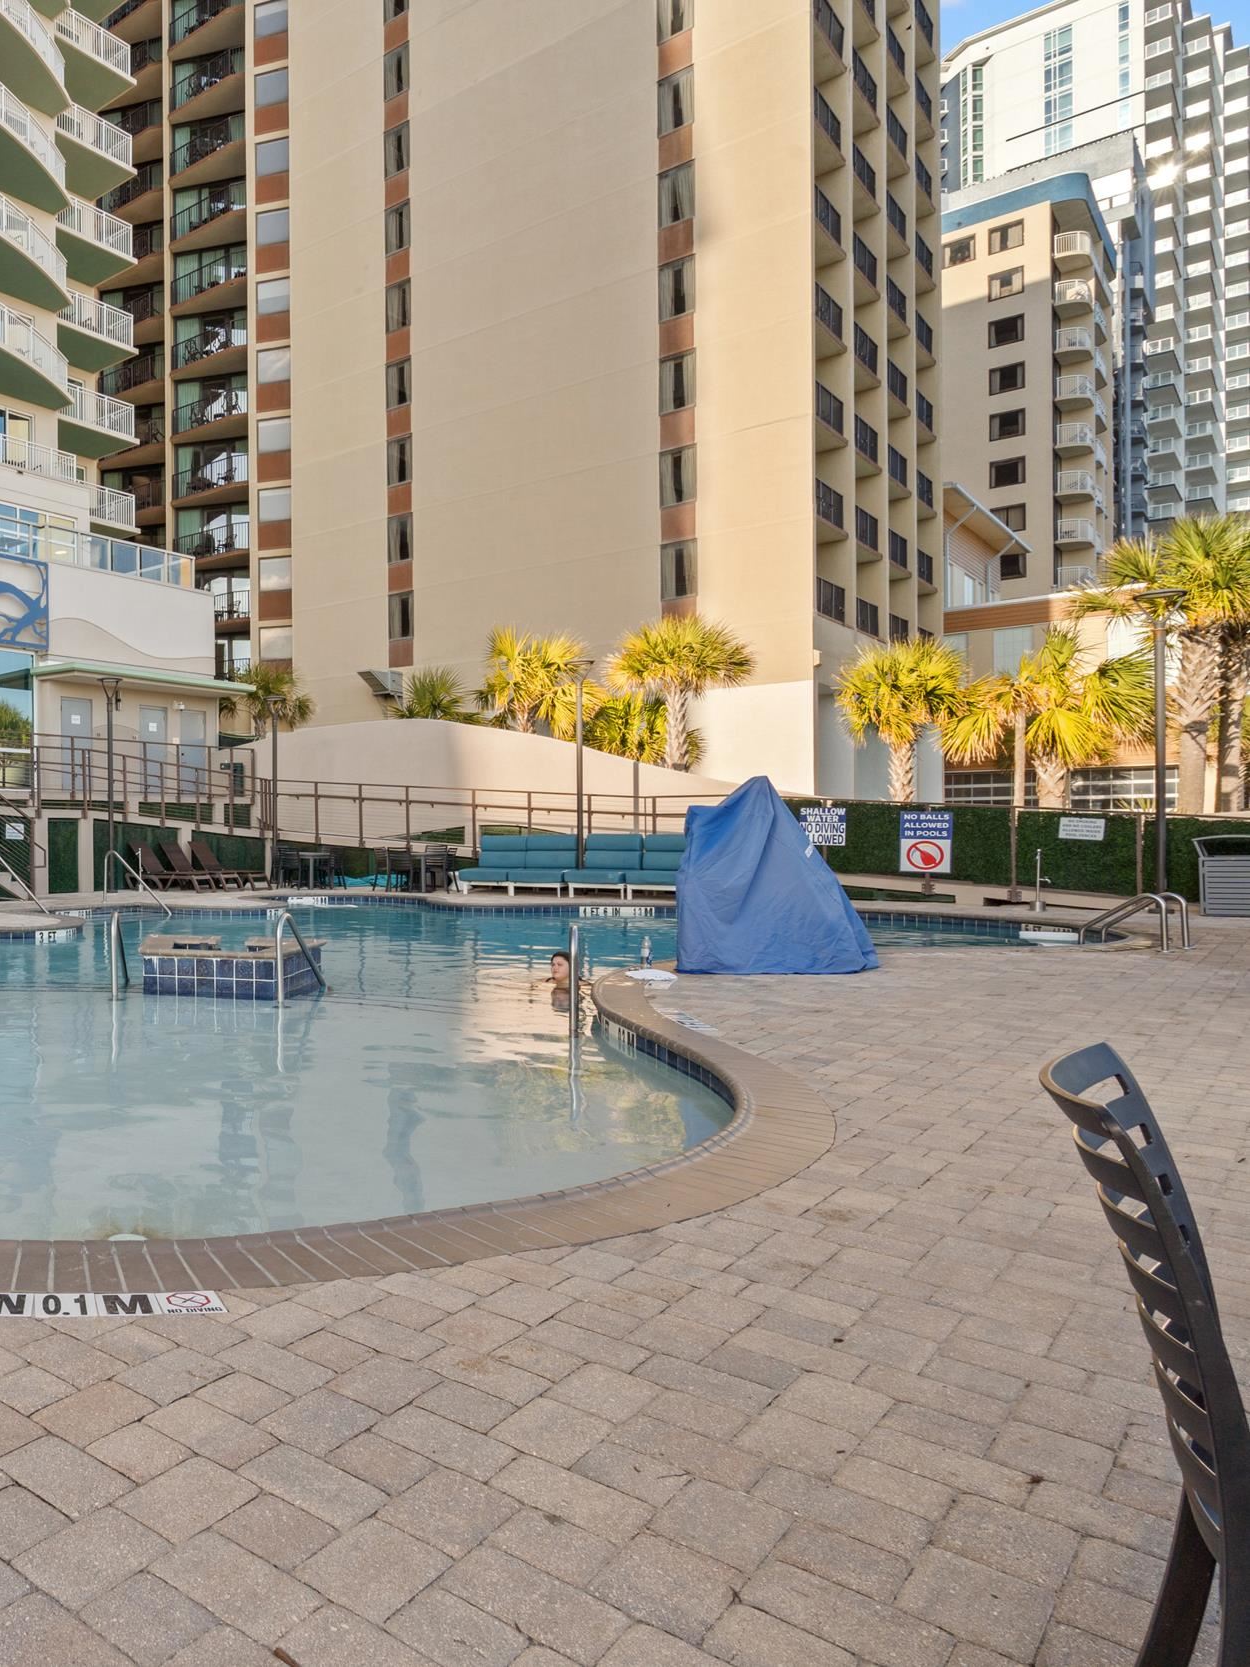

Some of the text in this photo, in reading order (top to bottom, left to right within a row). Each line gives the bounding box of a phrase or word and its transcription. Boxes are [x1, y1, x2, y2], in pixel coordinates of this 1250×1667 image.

[800, 807, 846, 815] SHALLOW
[815, 823, 845, 834] DIVING
[811, 833, 844, 845] LOWED
[611, 907, 621, 917] IN
[42, 1294, 88, 1316] 0.1
[102, 1294, 154, 1315] M
